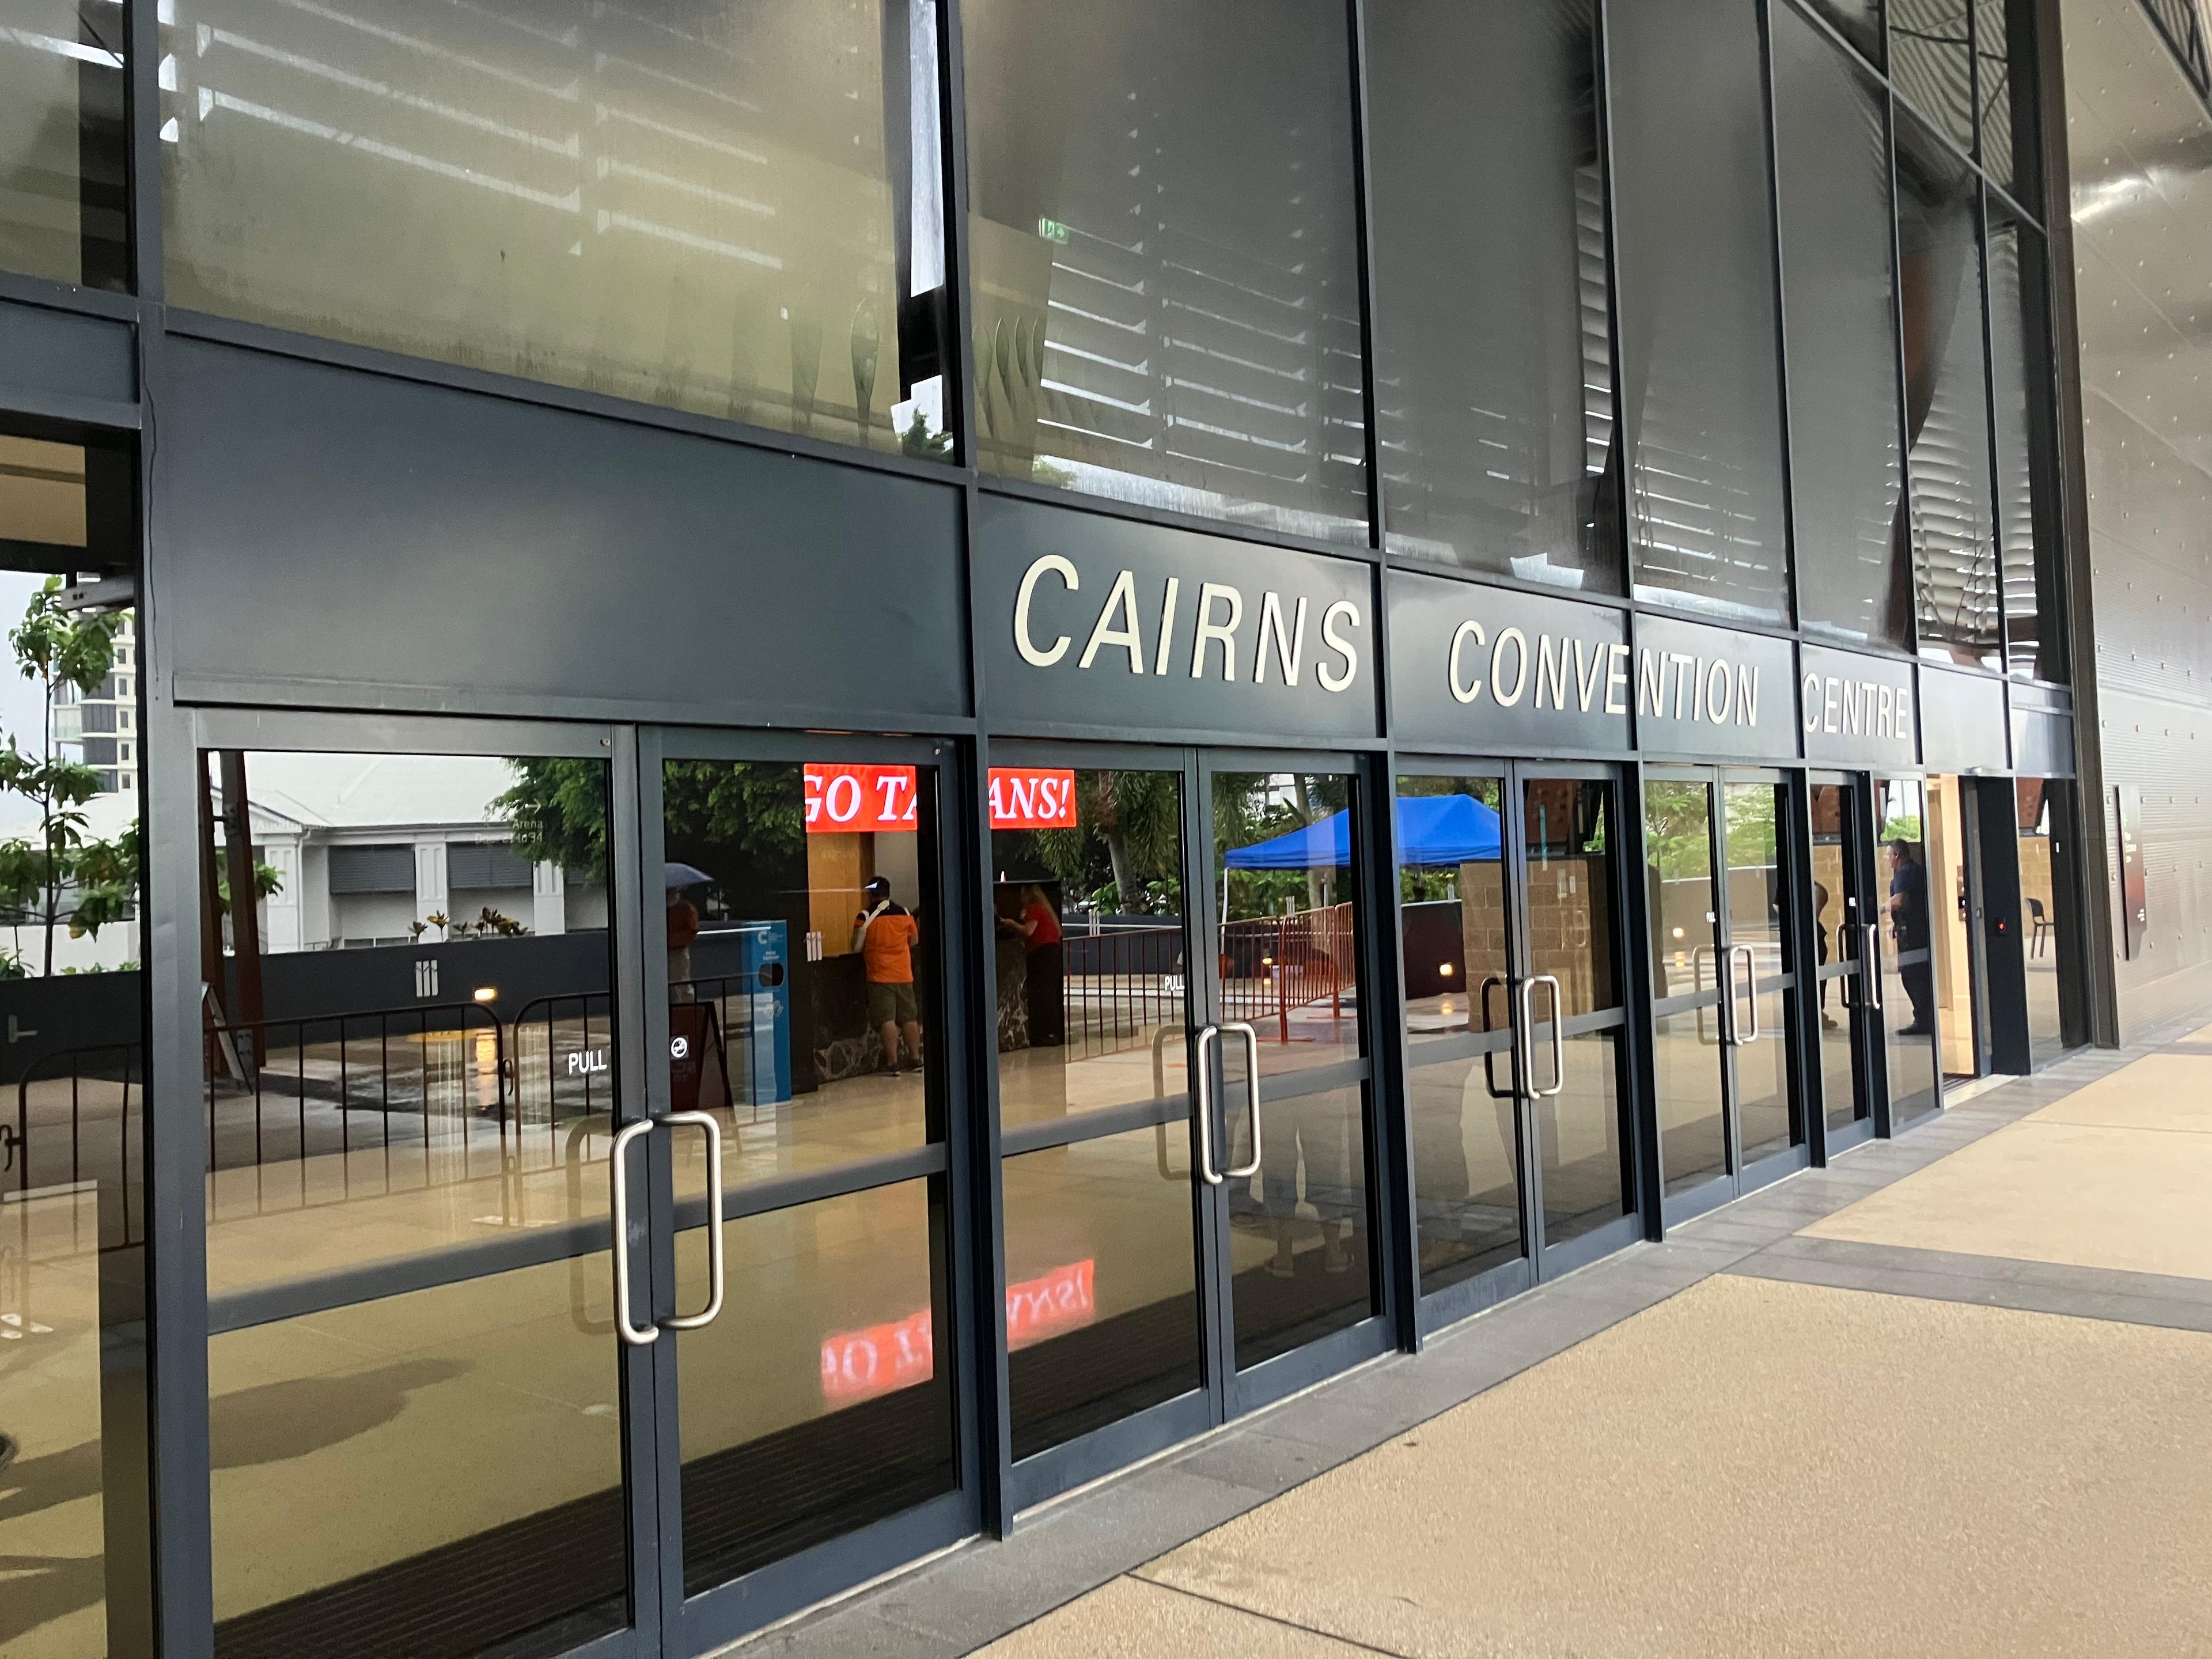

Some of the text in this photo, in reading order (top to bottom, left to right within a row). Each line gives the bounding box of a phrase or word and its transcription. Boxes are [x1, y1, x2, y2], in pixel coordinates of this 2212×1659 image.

[1014, 554, 1908, 739] CAIRNS CONVENTION CENTRE
[513, 818, 543, 830] Arena
[1164, 974, 1185, 991] PULL
[568, 1049, 608, 1075] PULL
